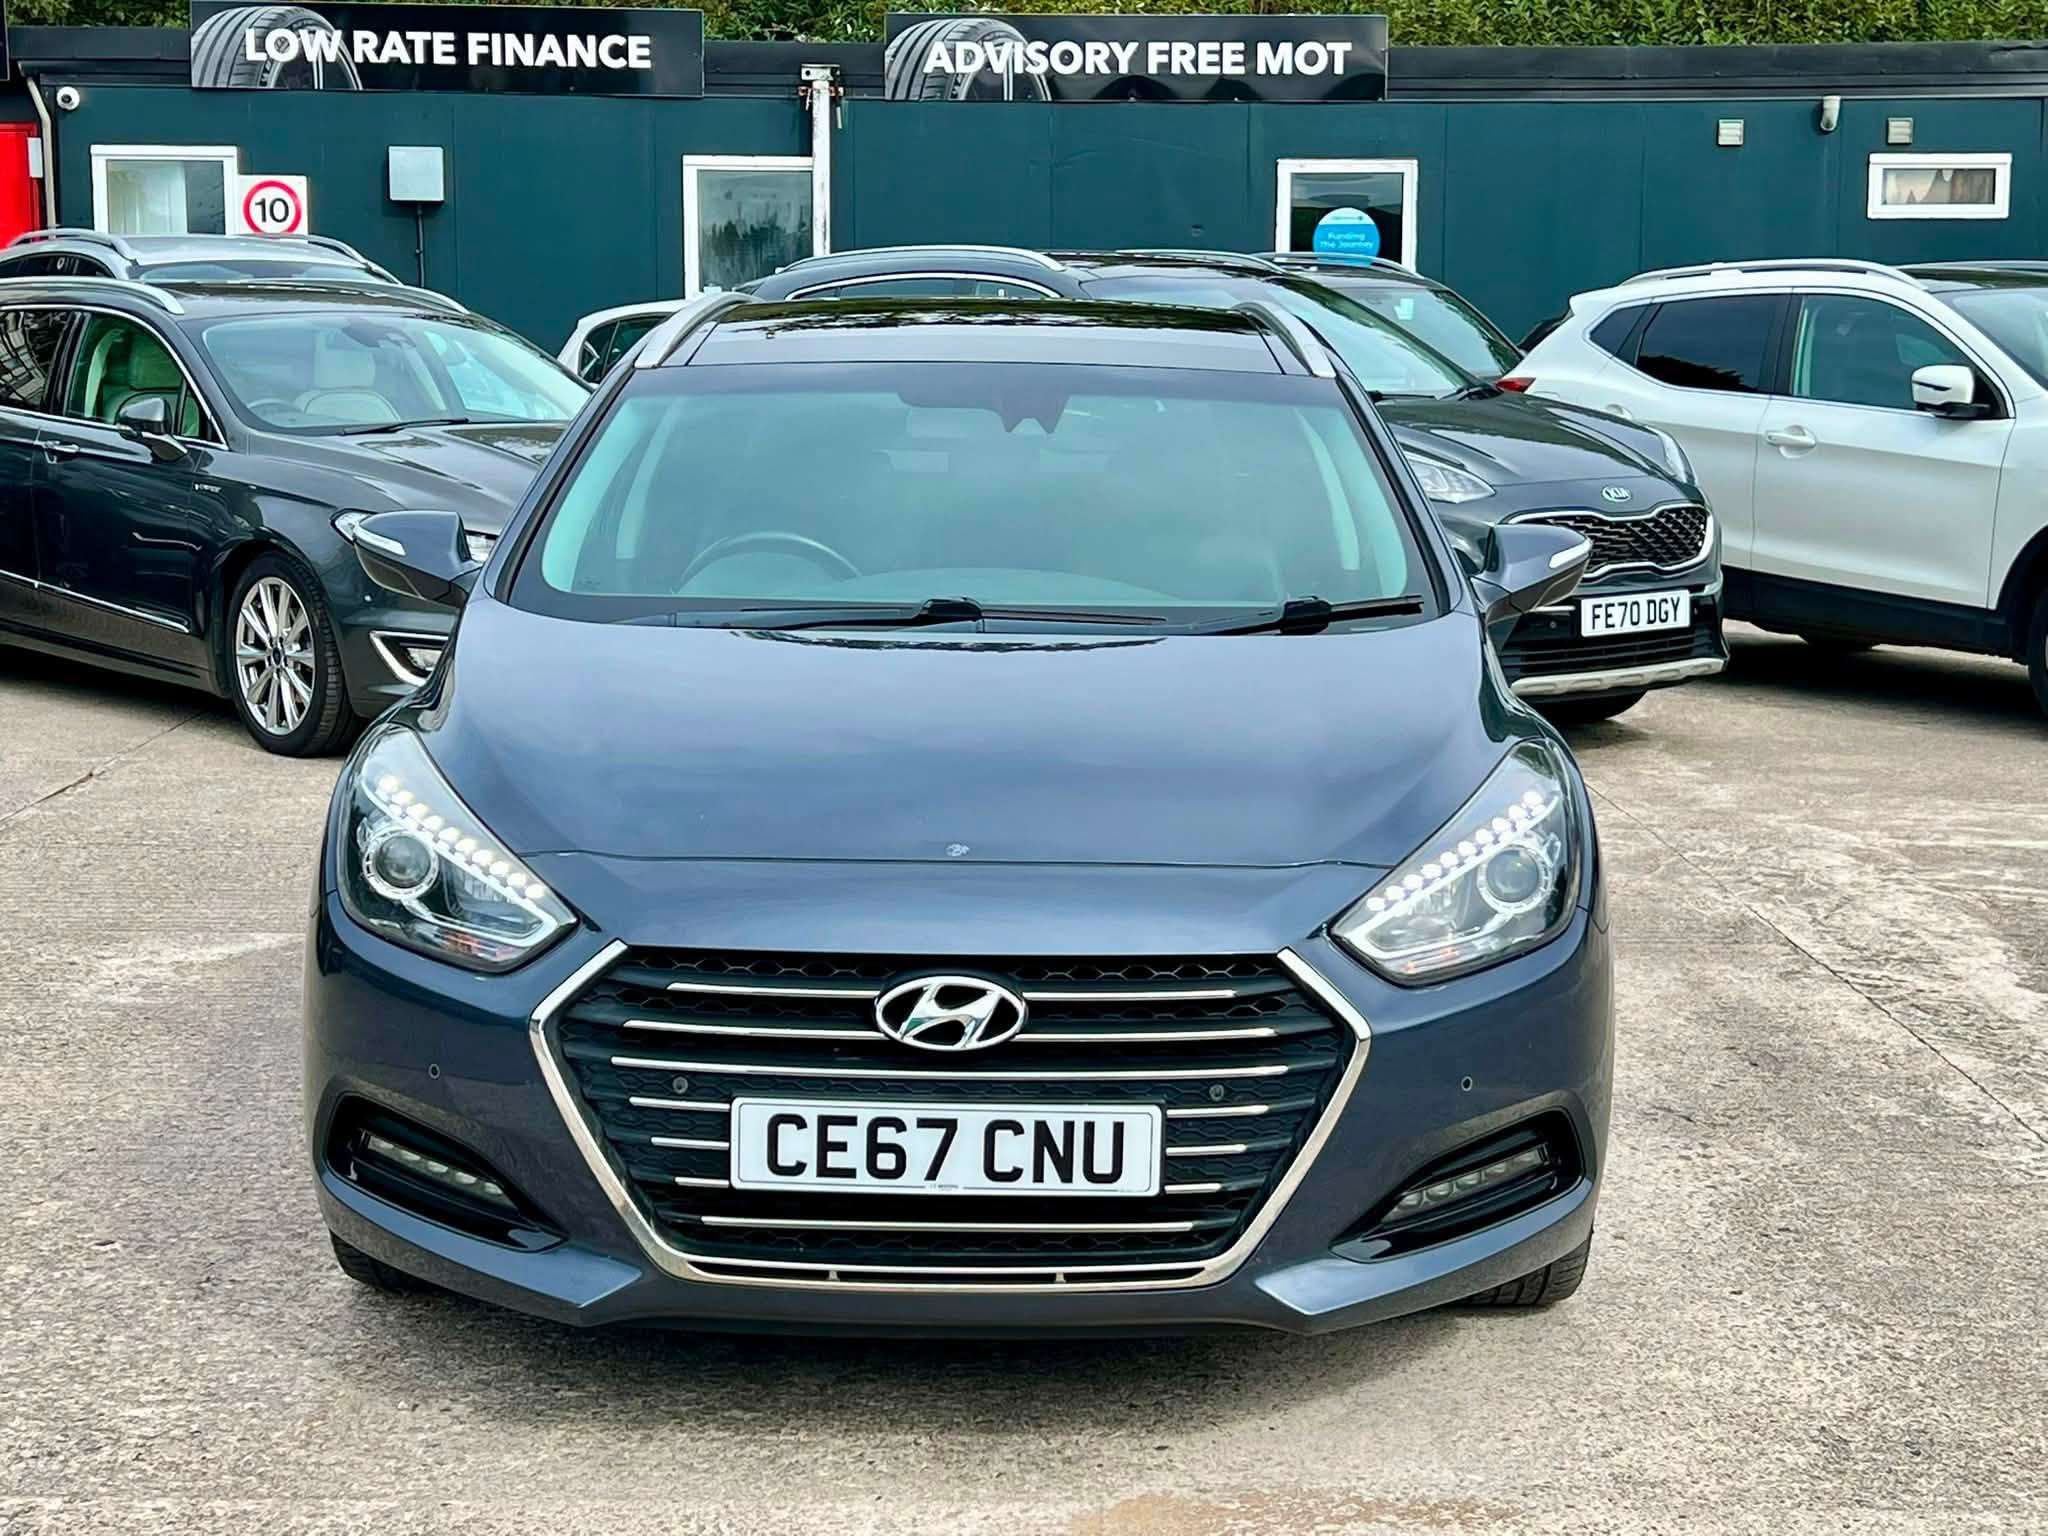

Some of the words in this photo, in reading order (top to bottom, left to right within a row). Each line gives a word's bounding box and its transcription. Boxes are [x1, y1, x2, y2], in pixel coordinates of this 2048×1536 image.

[245, 28, 342, 62] LOW
[352, 30, 456, 64] RATE
[467, 32, 652, 69] FINANCE
[922, 40, 1139, 75] ADVISORY
[1147, 41, 1246, 75] FREE
[1256, 41, 1353, 76] MOT
[255, 198, 289, 223] 10
[1320, 240, 1336, 248] The
[1327, 231, 1366, 241] Funding
[1605, 487, 1630, 500] KIA
[1592, 601, 1640, 630] FE70
[1646, 597, 1680, 624] DGY
[766, 1113, 959, 1181] CE67
[982, 1119, 1125, 1184] CNU
